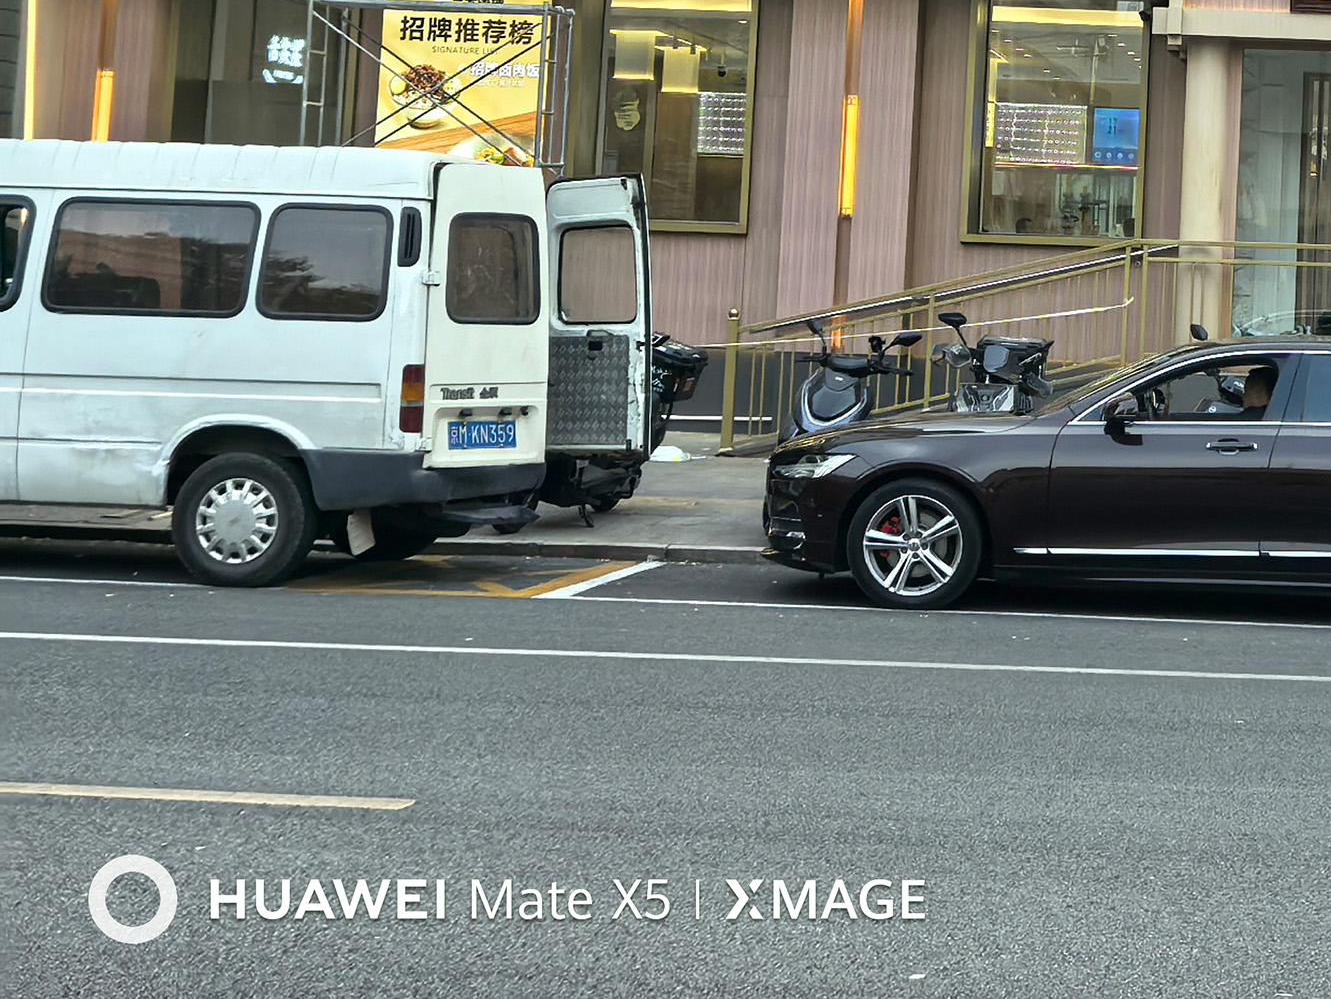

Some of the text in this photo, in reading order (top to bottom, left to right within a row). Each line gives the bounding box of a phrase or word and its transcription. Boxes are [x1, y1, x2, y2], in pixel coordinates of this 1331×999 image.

[400, 16, 535, 45] 招牌推荐榜
[432, 45, 480, 55] SIGNATURE
